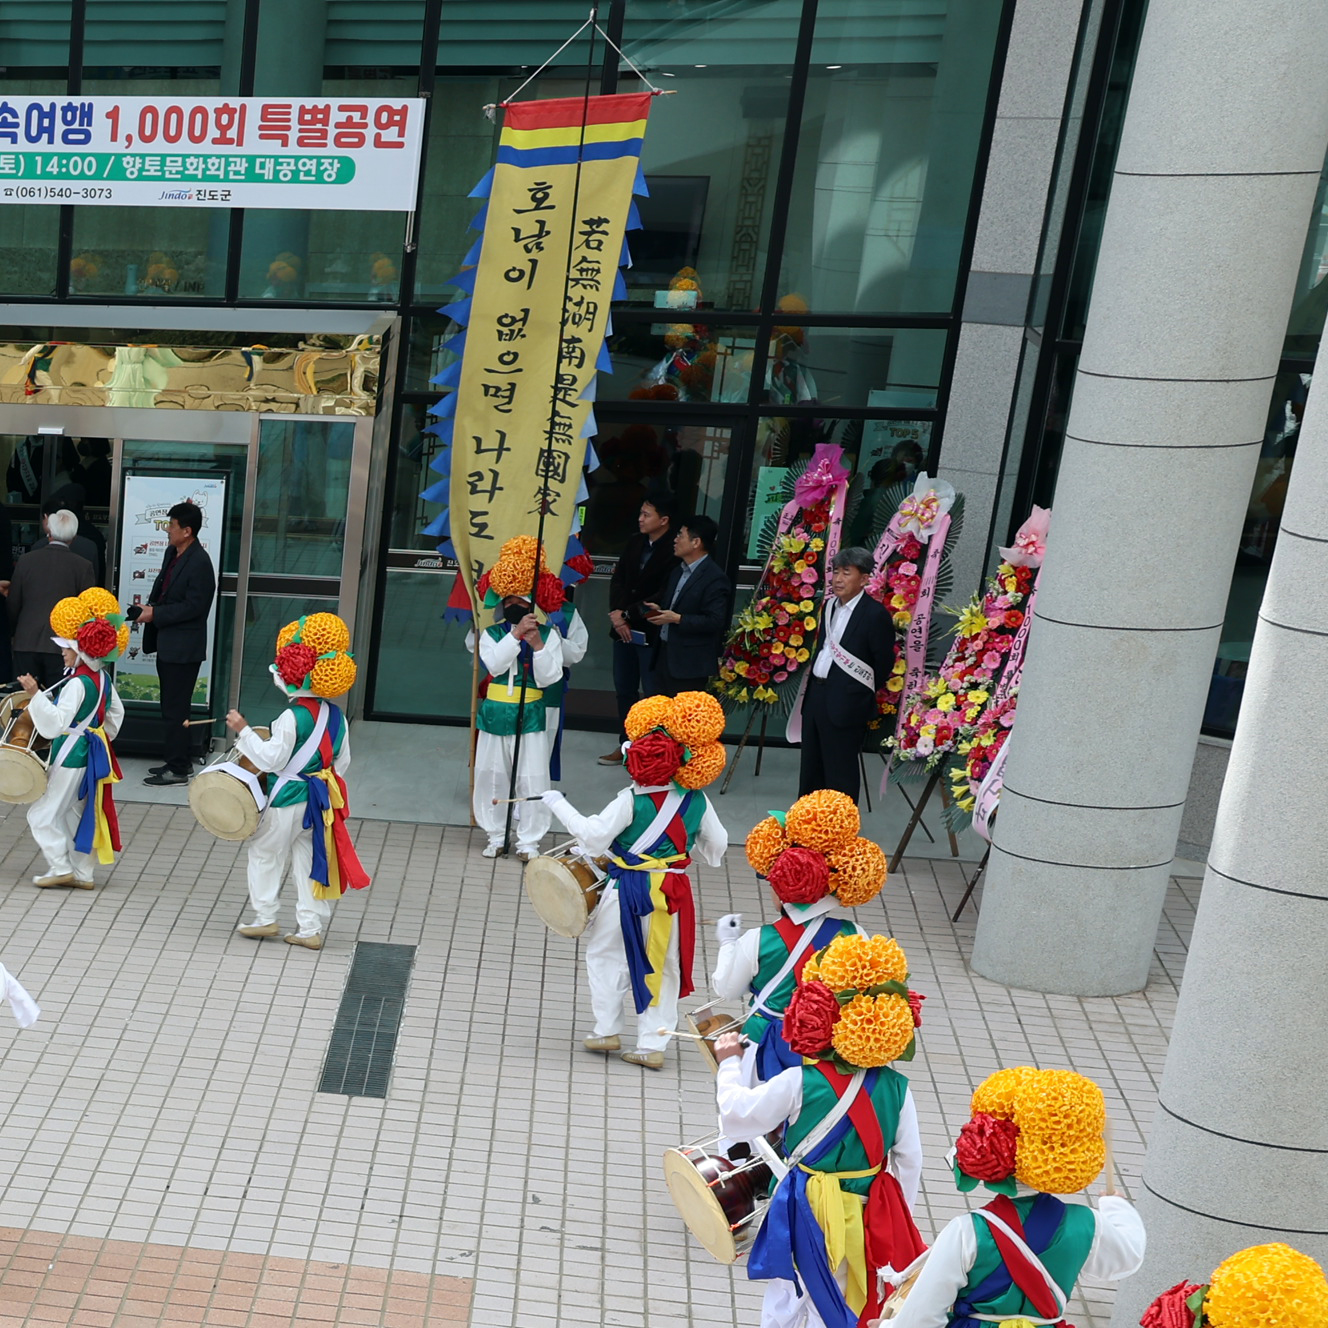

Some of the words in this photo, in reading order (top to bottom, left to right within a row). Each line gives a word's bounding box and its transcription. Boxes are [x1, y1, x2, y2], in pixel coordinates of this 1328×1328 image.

[105, 102, 247, 149] 1,000회
[258, 103, 409, 149] 특별공연
[35, 155, 98, 176] 14:00
[121, 155, 249, 180] 향토문화회관
[254, 156, 341, 182] 대공연장
[158, 188, 192, 201] Jindo
[194, 188, 232, 202] 진도군
[504, 181, 557, 291] 호남이
[481, 308, 531, 414] 없으면
[466, 430, 512, 541] 나라도
[154, 519, 170, 532] TO
